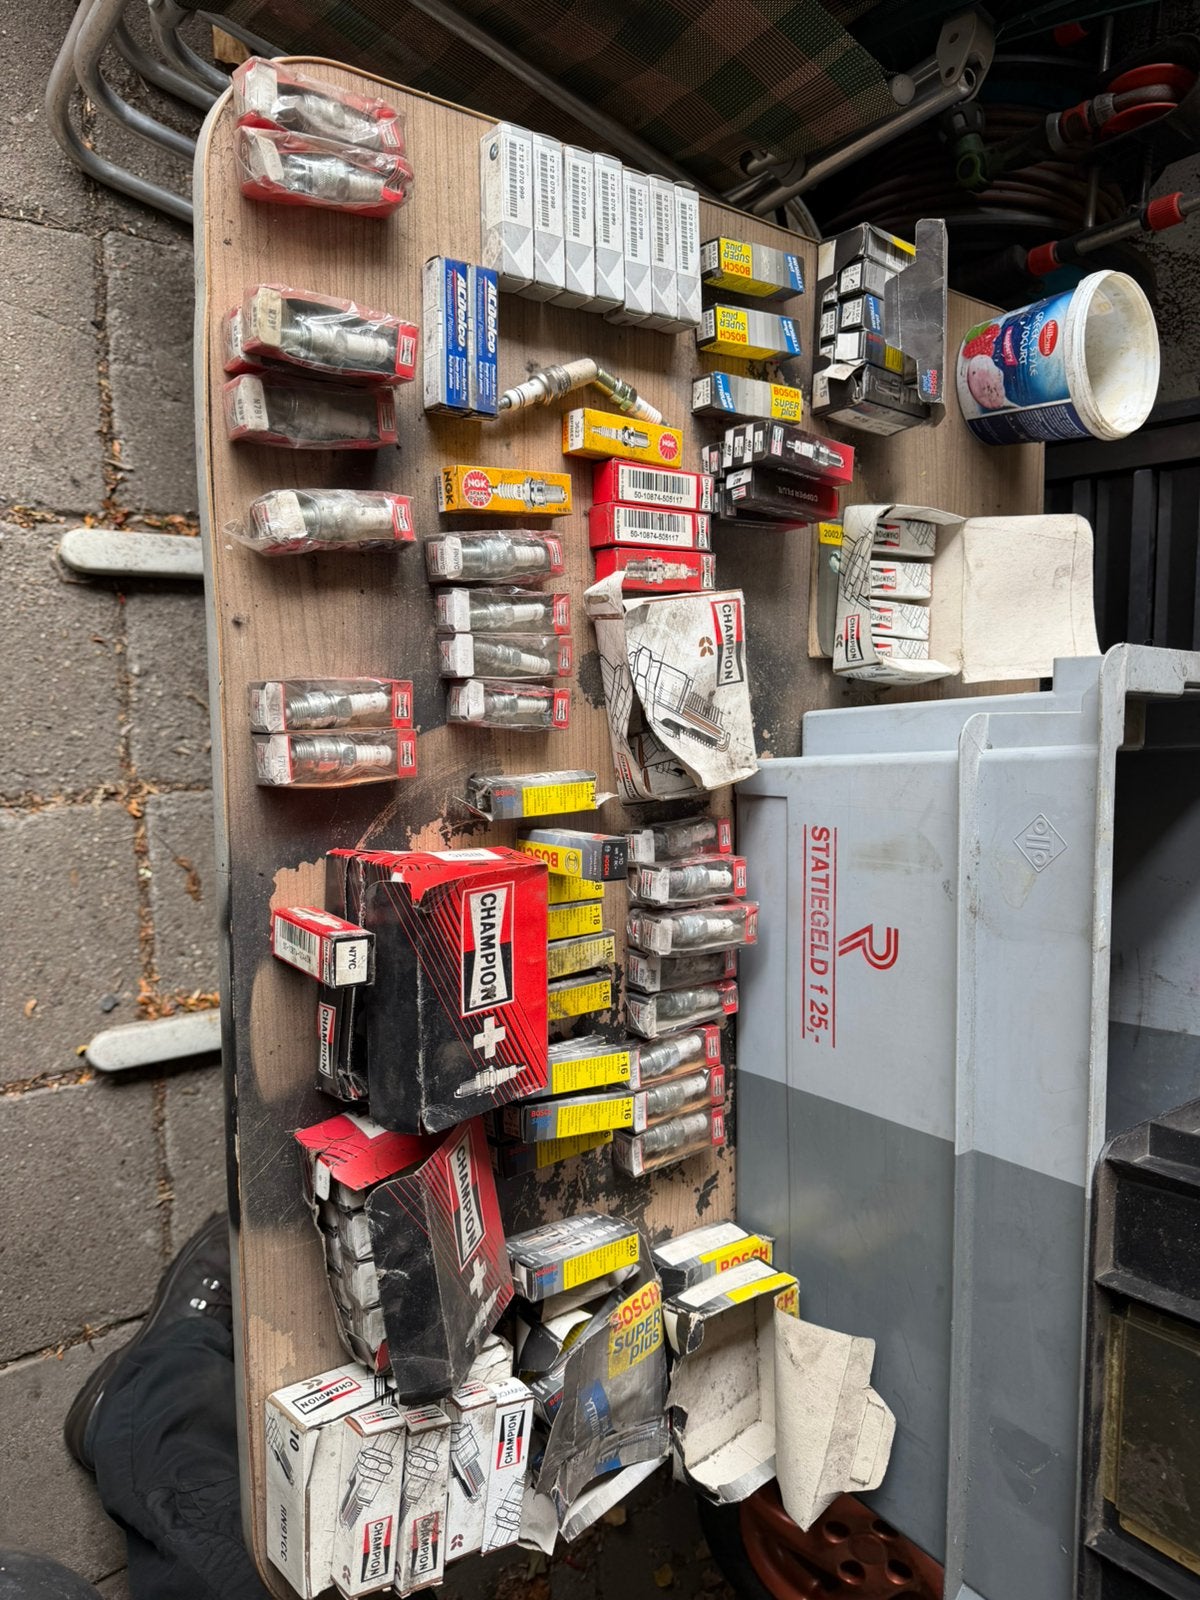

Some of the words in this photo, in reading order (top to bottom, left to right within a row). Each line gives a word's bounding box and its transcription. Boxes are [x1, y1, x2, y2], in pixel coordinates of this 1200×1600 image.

[519, 155, 524, 164] 12
[724, 250, 750, 263] SUPER
[726, 242, 743, 252] plus
[724, 262, 750, 276] BOSCH
[457, 272, 467, 348] ACDelco
[487, 280, 497, 353] ACDelco
[722, 310, 738, 320] plus
[720, 320, 745, 331] SUPER
[720, 330, 747, 342] BOSCH
[1032, 312, 1044, 343] GREEK
[1020, 324, 1031, 364] YOGURT
[1030, 346, 1038, 376] STYLE
[716, 376, 728, 408] YTTRIUM
[774, 387, 799, 399] BOSCH
[774, 398, 800, 410] SUPER
[781, 406, 797, 417] plus
[662, 439, 676, 447] NGK
[443, 471, 453, 504] NGK
[467, 479, 486, 488] NGK
[722, 604, 734, 680] CHAMPION
[620, 755, 636, 799] CHAMPION
[809, 825, 830, 976] STATIEGELD
[480, 893, 497, 1002] CHAMPION
[810, 984, 828, 996] f
[806, 1001, 829, 1044] 25,-
[456, 1145, 477, 1249] CHAMPION
[612, 1284, 660, 1333] BOSCH
[614, 1310, 661, 1354] SUPER
[629, 1333, 660, 1363] plus
[299, 1381, 353, 1413] CHAMPION
[457, 1384, 488, 1397] CHAMPION
[363, 1408, 396, 1421] CHAMPION
[409, 1409, 441, 1422] CHAMPION
[289, 1429, 300, 1452] 10
[505, 1416, 517, 1465] CHAMPION
[369, 1522, 383, 1577] CHAMPION
[420, 1517, 430, 1571] CHAMPION
